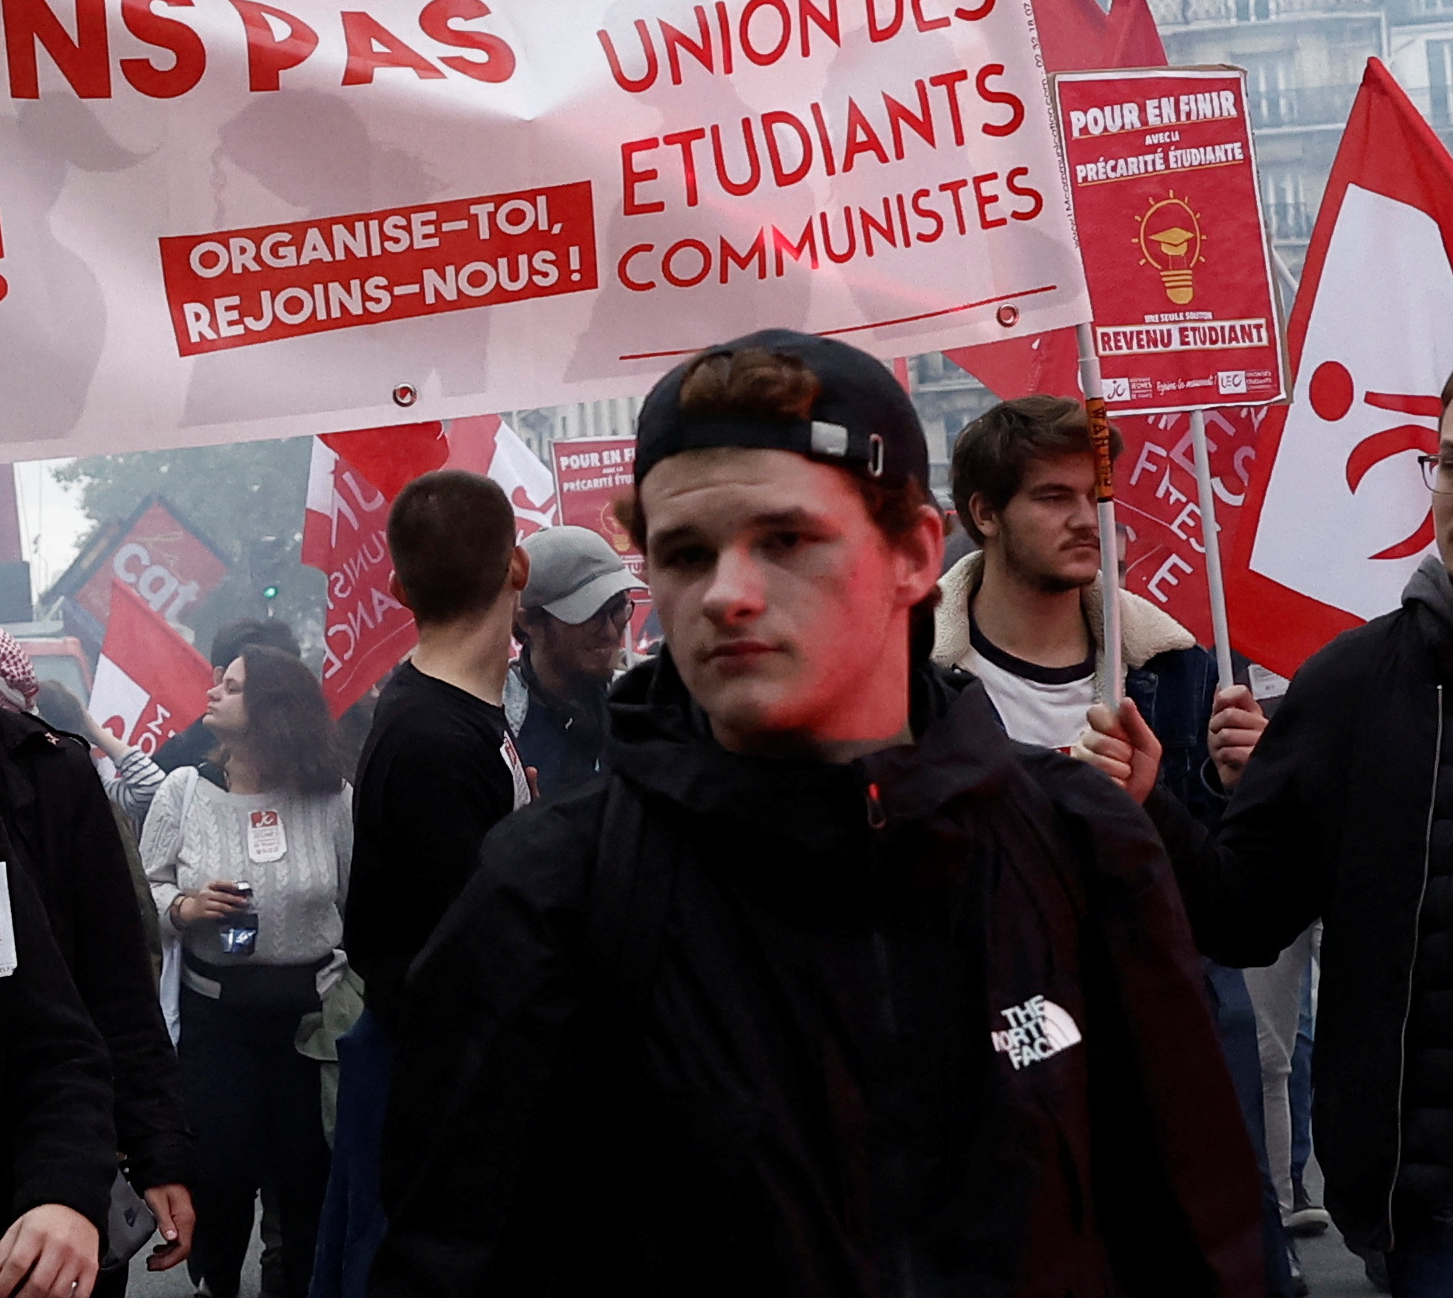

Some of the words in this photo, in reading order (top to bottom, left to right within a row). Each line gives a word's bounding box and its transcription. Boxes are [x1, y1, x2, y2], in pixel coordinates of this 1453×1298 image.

[1070, 100, 1141, 137] POUR
[1146, 95, 1176, 126] EN
[1180, 89, 1237, 121] FINIR
[621, 63, 1026, 216] ETUDIANTS
[1145, 131, 1171, 146] AVEC
[1076, 147, 1165, 183] PRÉCARITÉ
[1169, 141, 1243, 169] ÉTUDIANTE
[190, 195, 563, 279] ORGANISE-TOI,
[618, 166, 1044, 292] COMMUNISTES
[1101, 328, 1172, 352] REVENU
[1179, 323, 1264, 346] ETUDIANT
[560, 451, 600, 471] POUR
[603, 449, 621, 466] EN
[563, 475, 613, 493] PRÉCARITÉ
[1000, 994, 1044, 1028] THE
[1008, 1037, 1054, 1070] FAC
